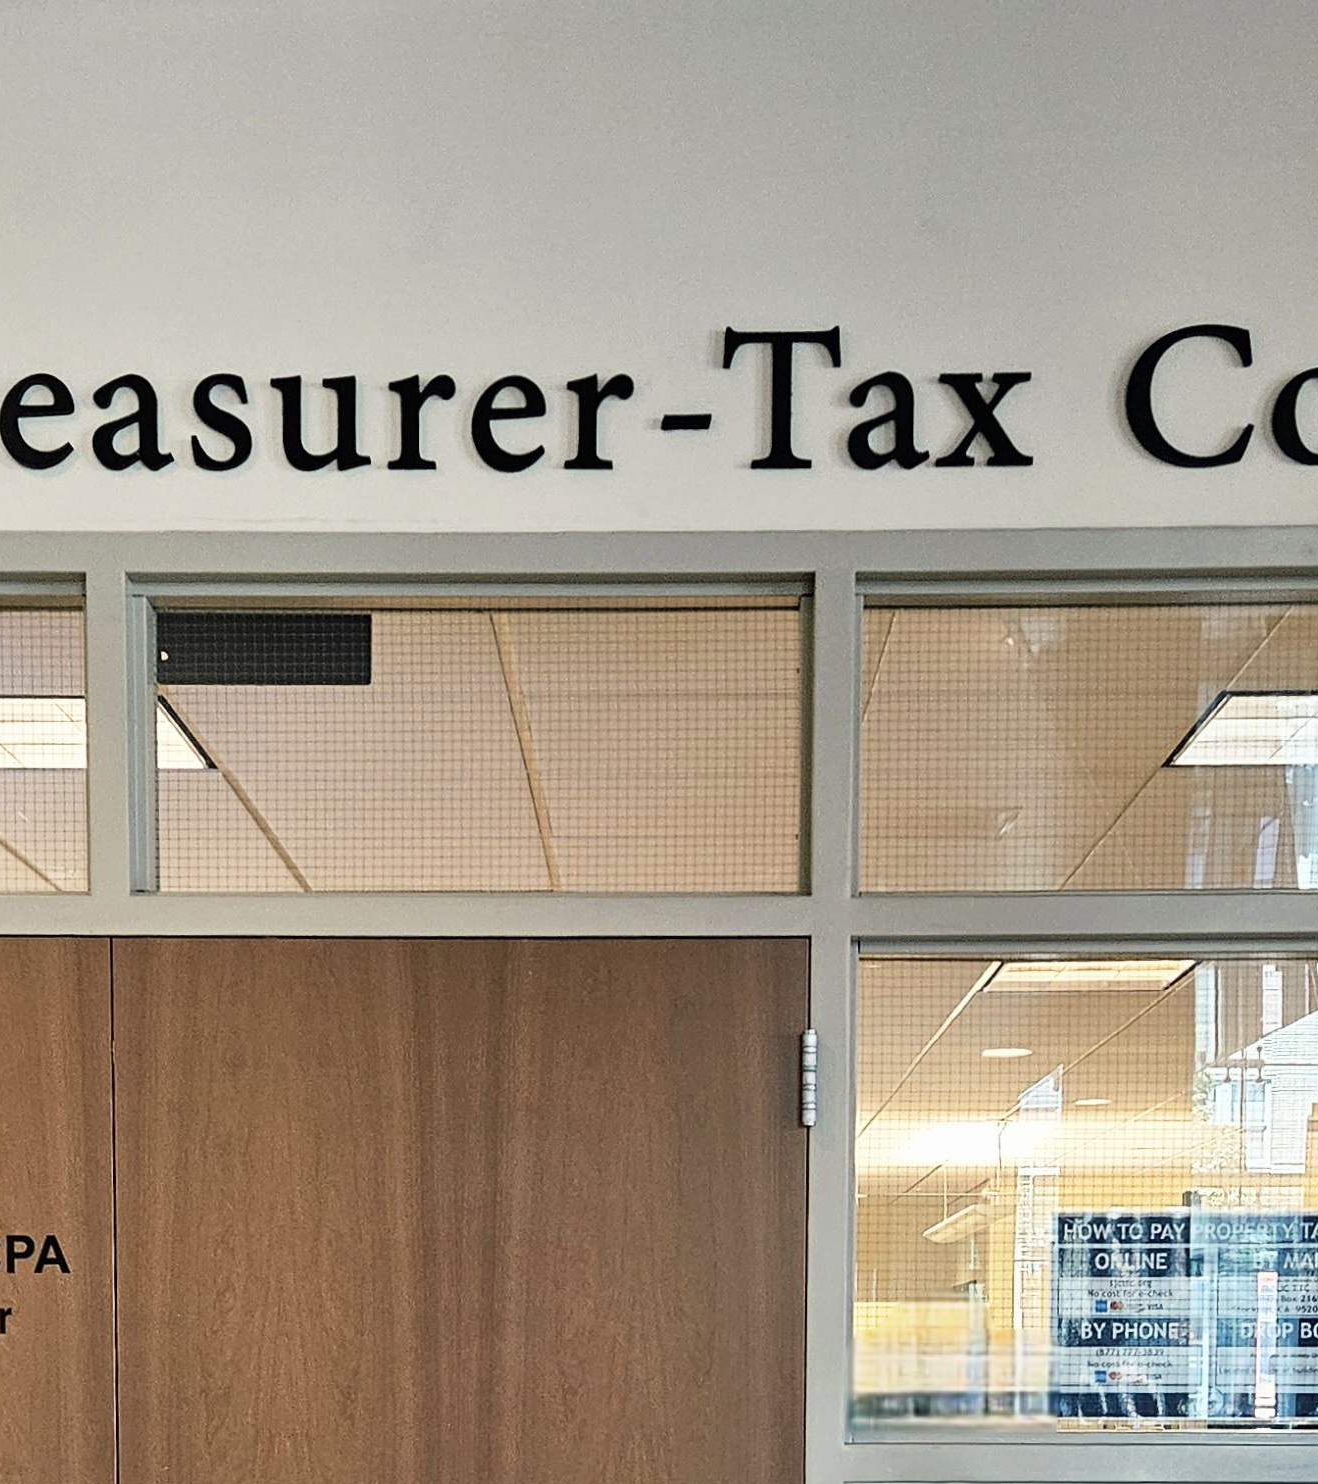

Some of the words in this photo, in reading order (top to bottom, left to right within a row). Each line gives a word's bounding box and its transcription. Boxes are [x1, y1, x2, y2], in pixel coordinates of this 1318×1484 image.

[1064, 1223, 1111, 1241] HOW
[1117, 1223, 1143, 1240] TO
[1150, 1223, 1186, 1240] PAY
[1195, 1222, 1294, 1240] PROPERTY
[1095, 1252, 1168, 1270] ONLINE
[1253, 1251, 1278, 1269] BY
[1081, 1322, 1106, 1340] BY
[1112, 1322, 1179, 1340] PHONE
